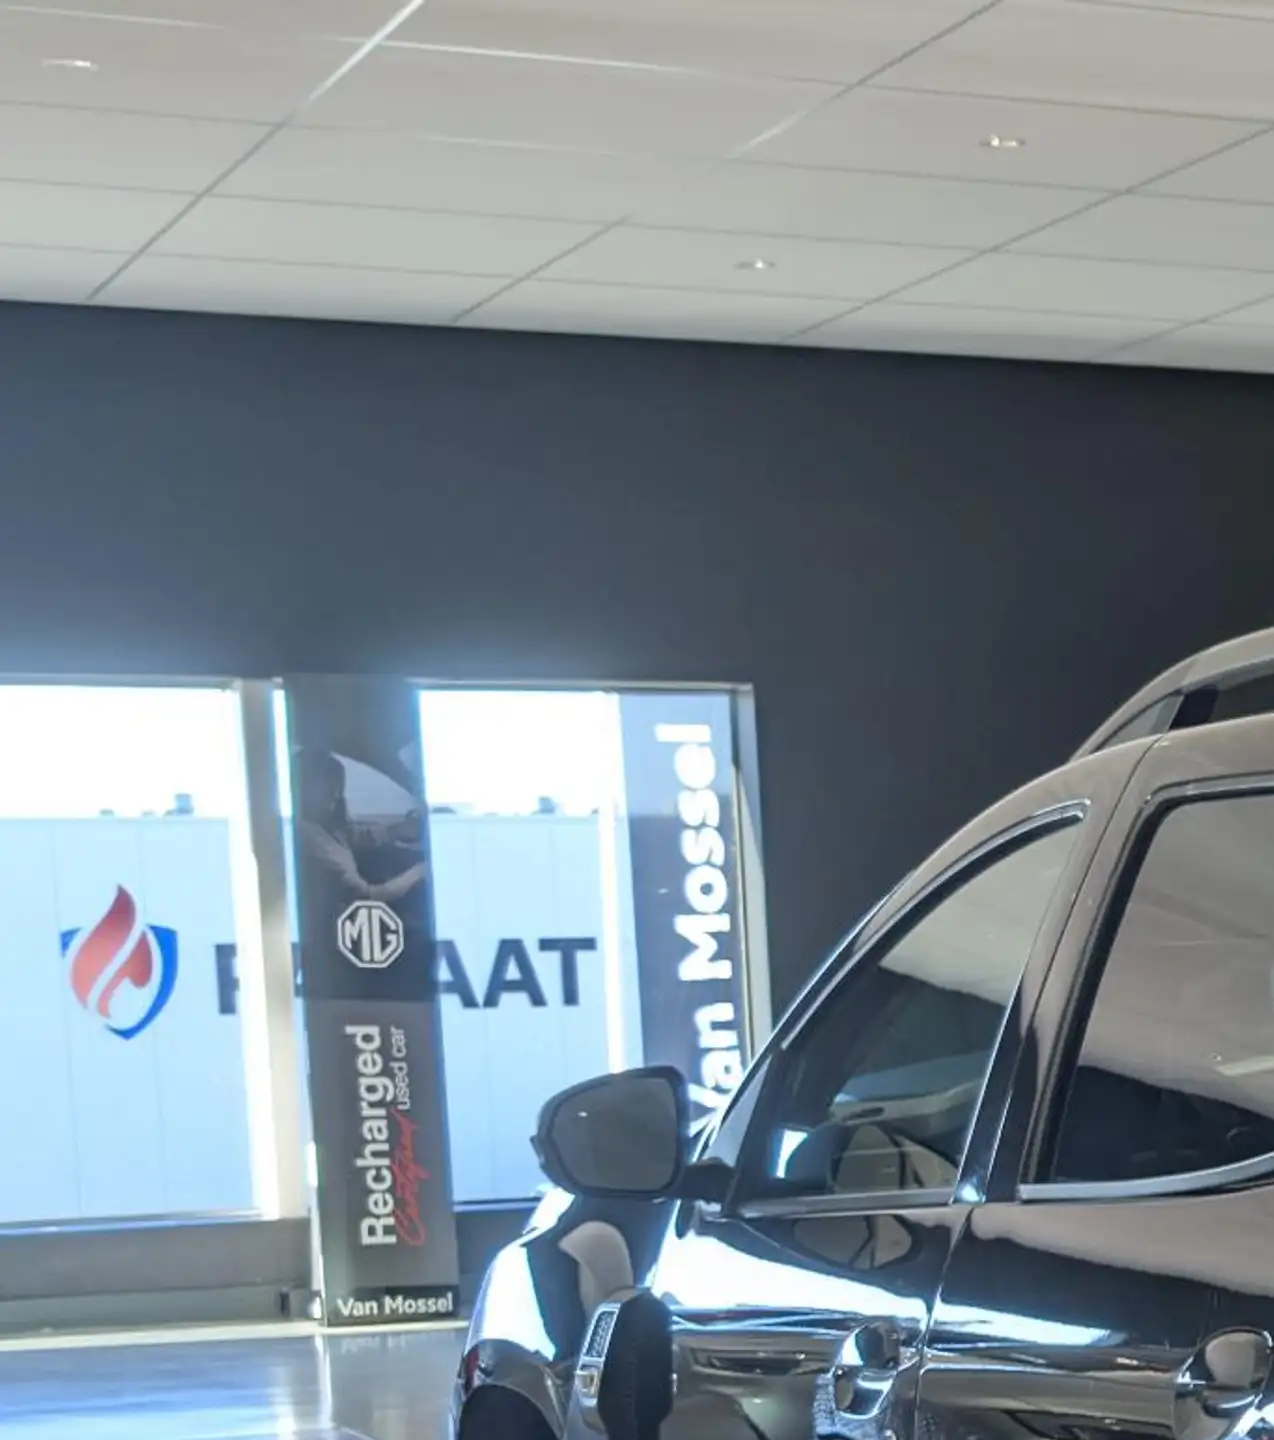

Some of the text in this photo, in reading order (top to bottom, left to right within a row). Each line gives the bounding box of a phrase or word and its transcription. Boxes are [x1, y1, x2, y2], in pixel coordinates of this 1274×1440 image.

[653, 723, 732, 981] Mossel
[343, 906, 399, 963] MG
[390, 1025, 407, 1058] car
[389, 1061, 411, 1110] used
[345, 1024, 397, 1247] Recharged
[336, 1290, 454, 1318] Van Mossel
